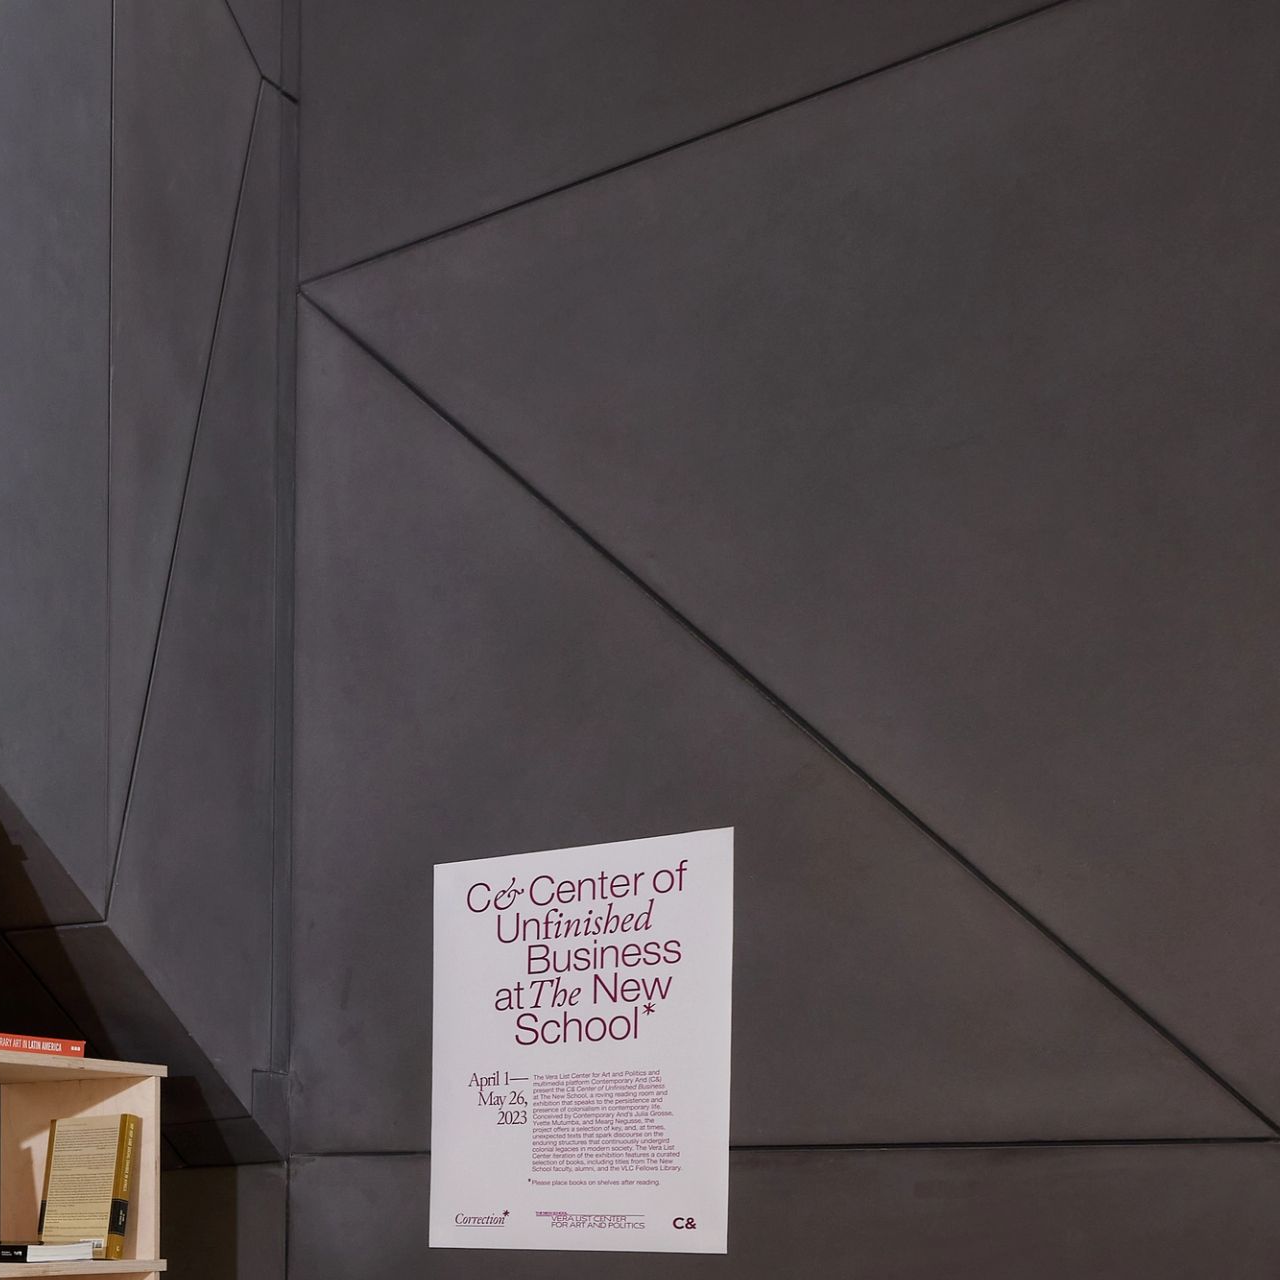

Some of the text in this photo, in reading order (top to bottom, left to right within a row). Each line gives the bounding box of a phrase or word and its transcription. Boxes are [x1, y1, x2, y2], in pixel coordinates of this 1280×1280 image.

[466, 860, 688, 912] C& Center of
[496, 898, 655, 943] Unfinished
[527, 939, 681, 974] Business
[495, 972, 672, 1011] at The New
[468, 1071, 501, 1088] April
[478, 1090, 528, 1109] May 26,
[496, 1111, 528, 1125] 2023
[673, 1217, 697, 1230] C&
